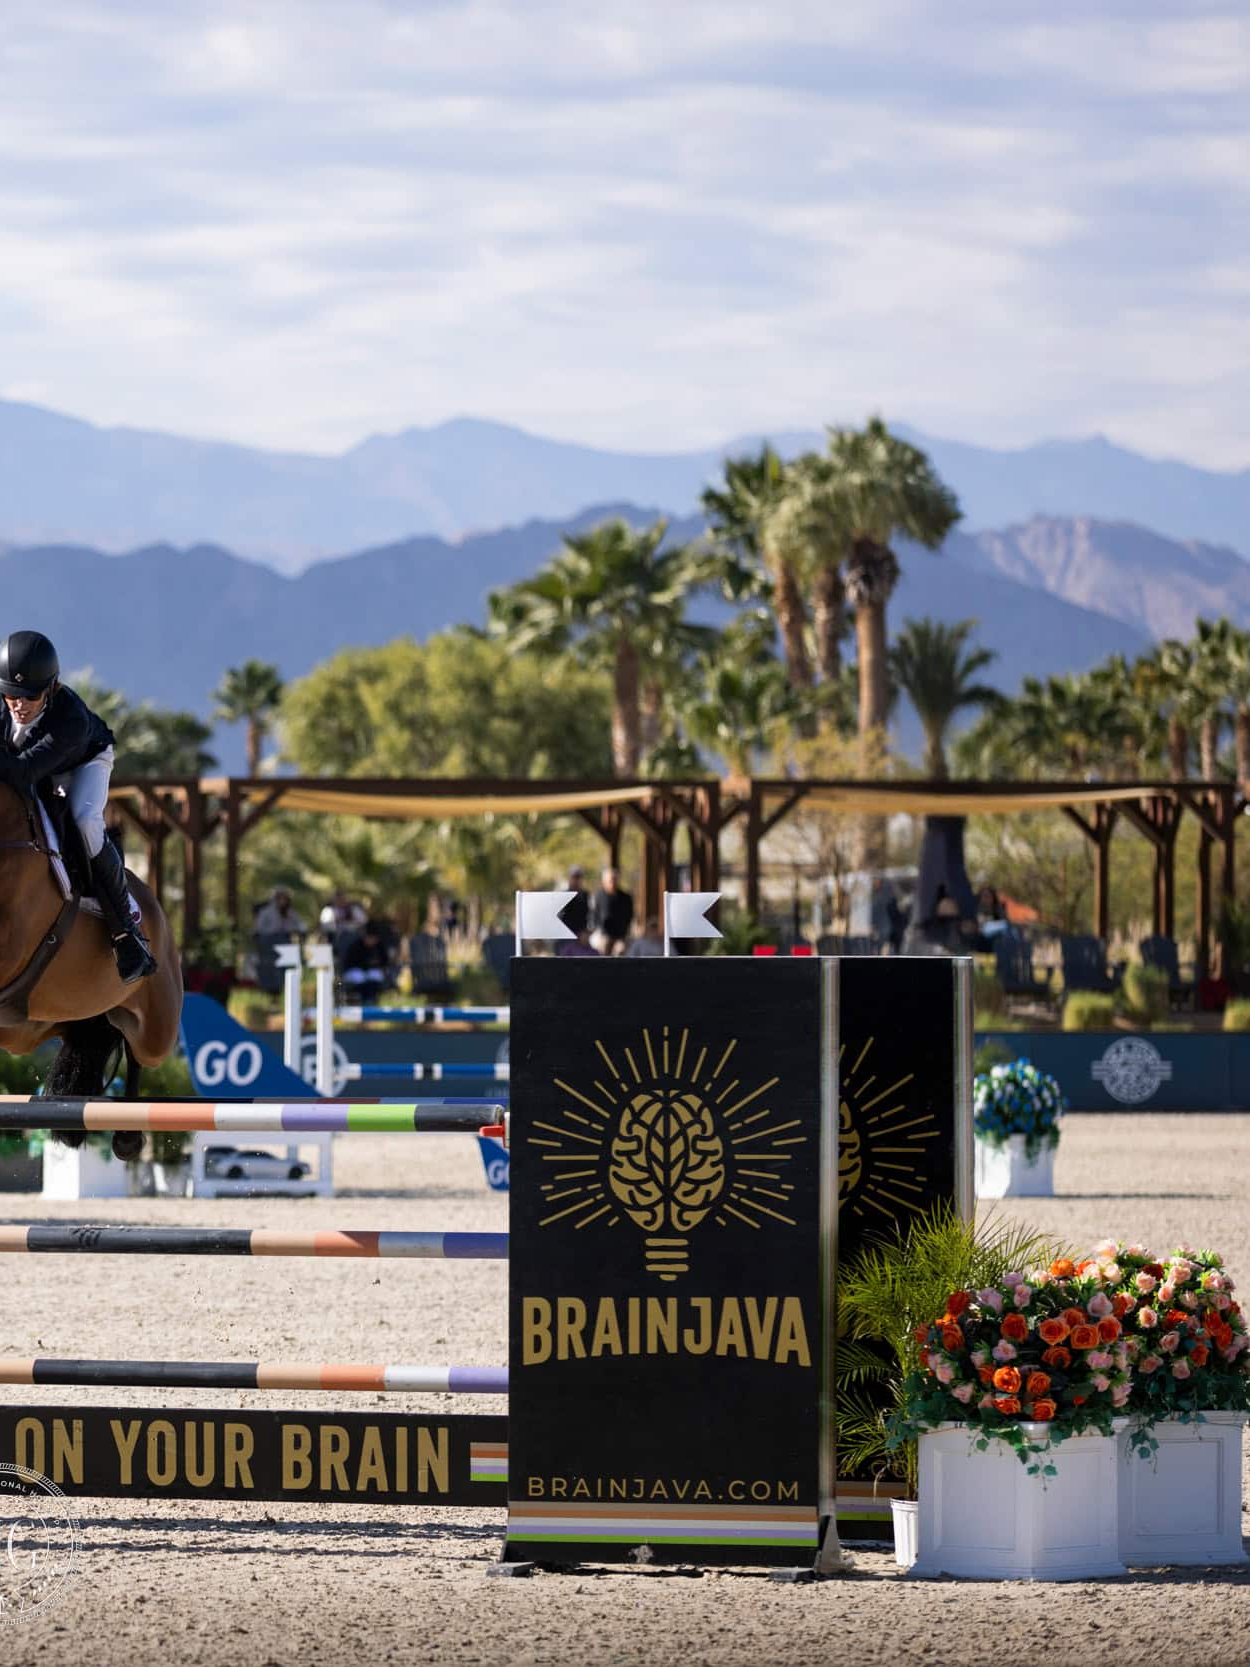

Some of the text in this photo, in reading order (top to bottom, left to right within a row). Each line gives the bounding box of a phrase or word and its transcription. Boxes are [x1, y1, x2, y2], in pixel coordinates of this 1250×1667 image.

[195, 1041, 262, 1086] GO
[488, 1159, 510, 1185] G
[522, 1296, 812, 1367] BRAINJAVA
[15, 1417, 84, 1485] ON
[110, 1419, 254, 1488] YOUR
[282, 1424, 449, 1493] BRAIN
[528, 1476, 799, 1500] BRAINJAVA.COM
